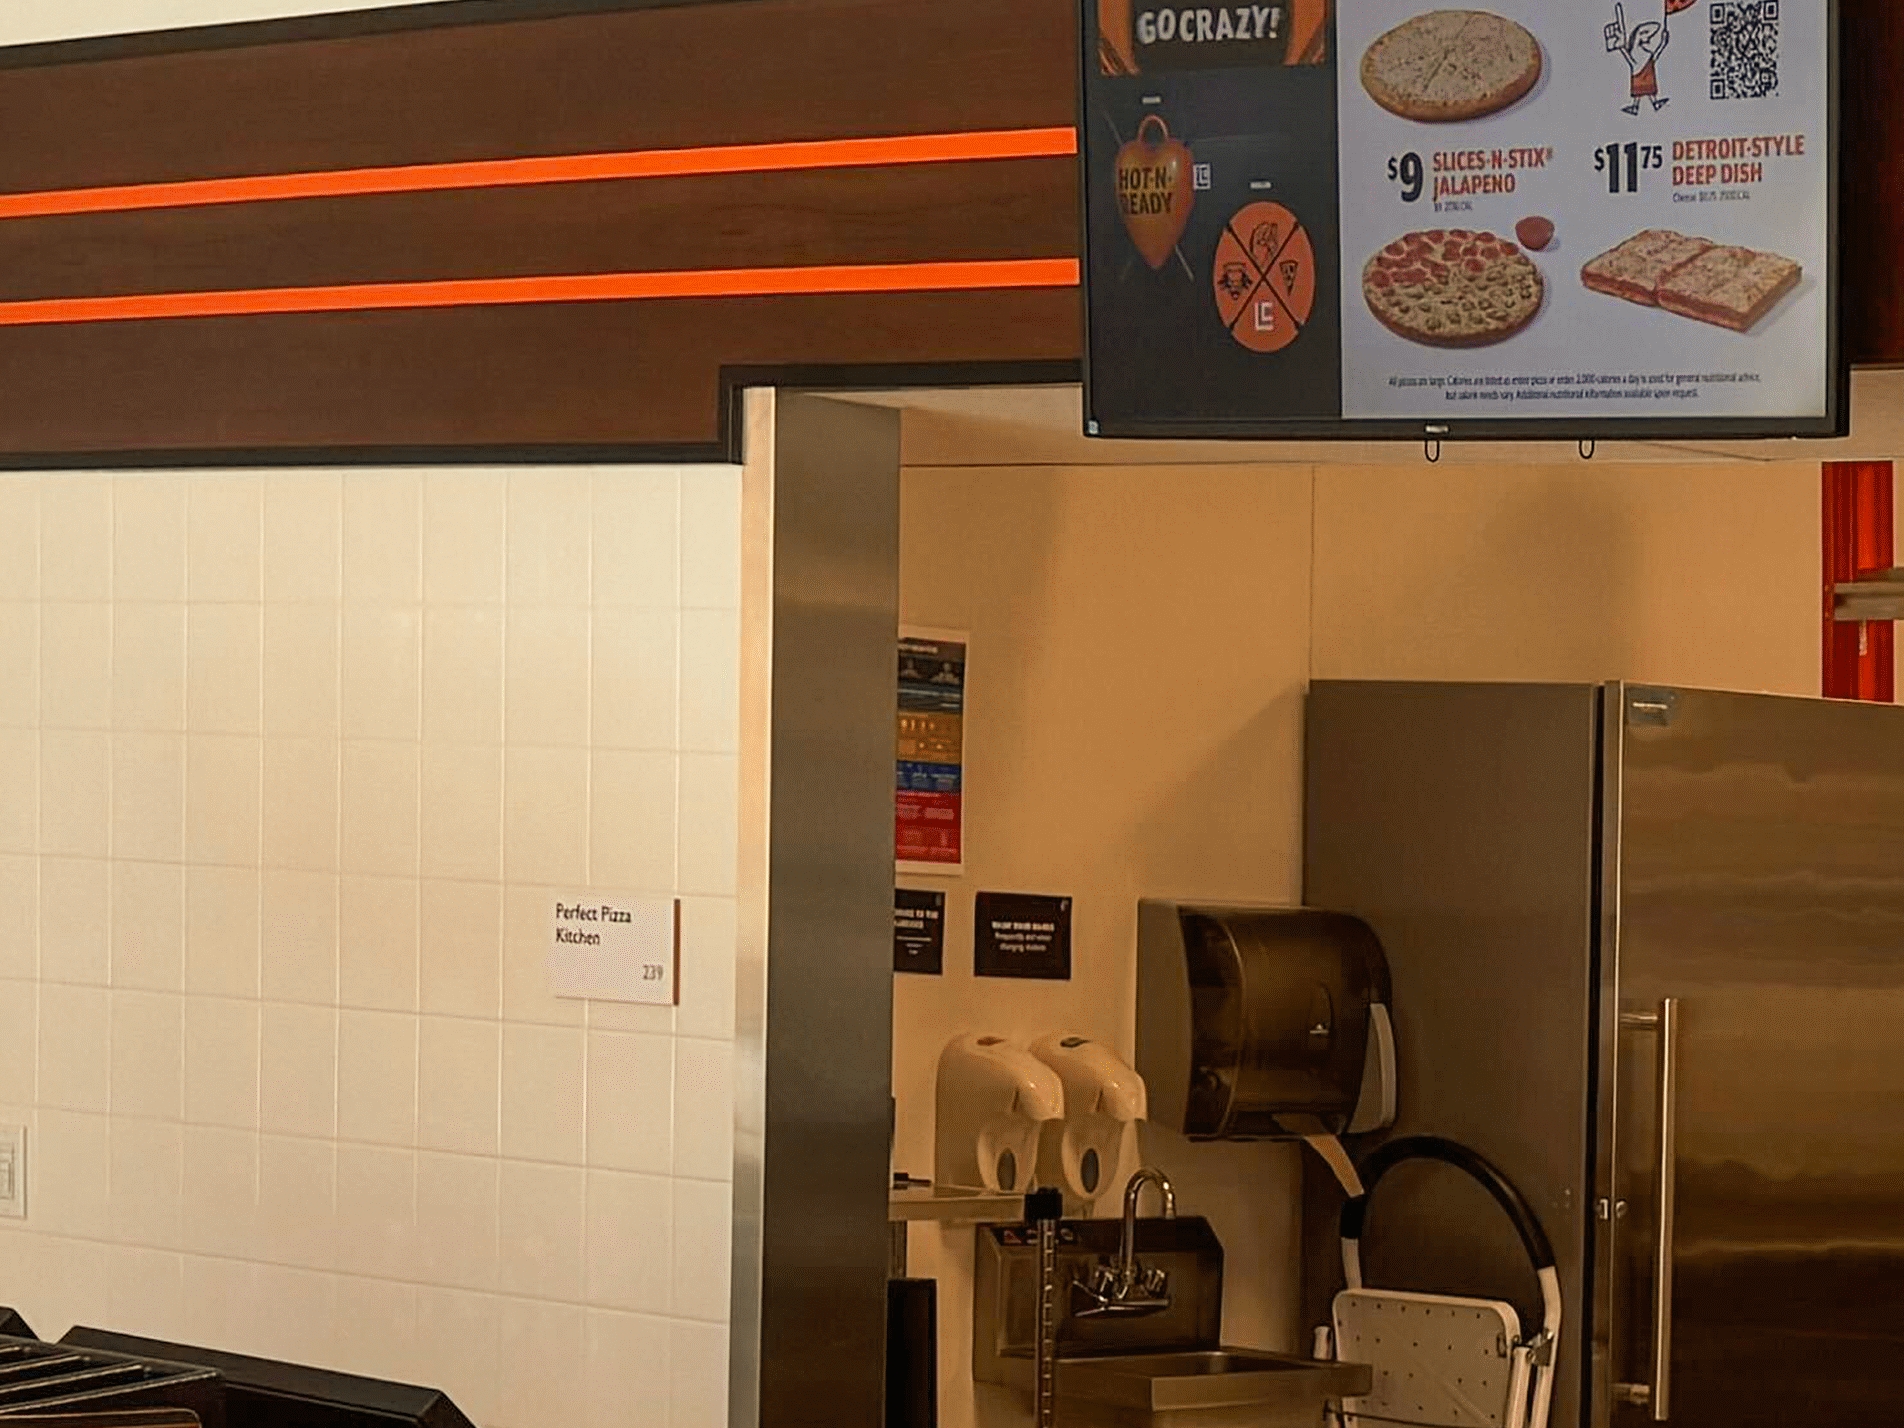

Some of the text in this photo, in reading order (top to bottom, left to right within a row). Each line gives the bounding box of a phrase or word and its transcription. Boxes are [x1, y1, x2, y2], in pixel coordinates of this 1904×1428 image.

[1137, 5, 1282, 45] GO CRAZY!
[1387, 151, 1424, 203] $9
[1433, 173, 1516, 202] JALAPENO
[1672, 161, 1763, 188] DEEP DISH
[555, 903, 632, 923] Perfect Pizza
[555, 927, 601, 946] Kitchen
[642, 963, 664, 981] 239
